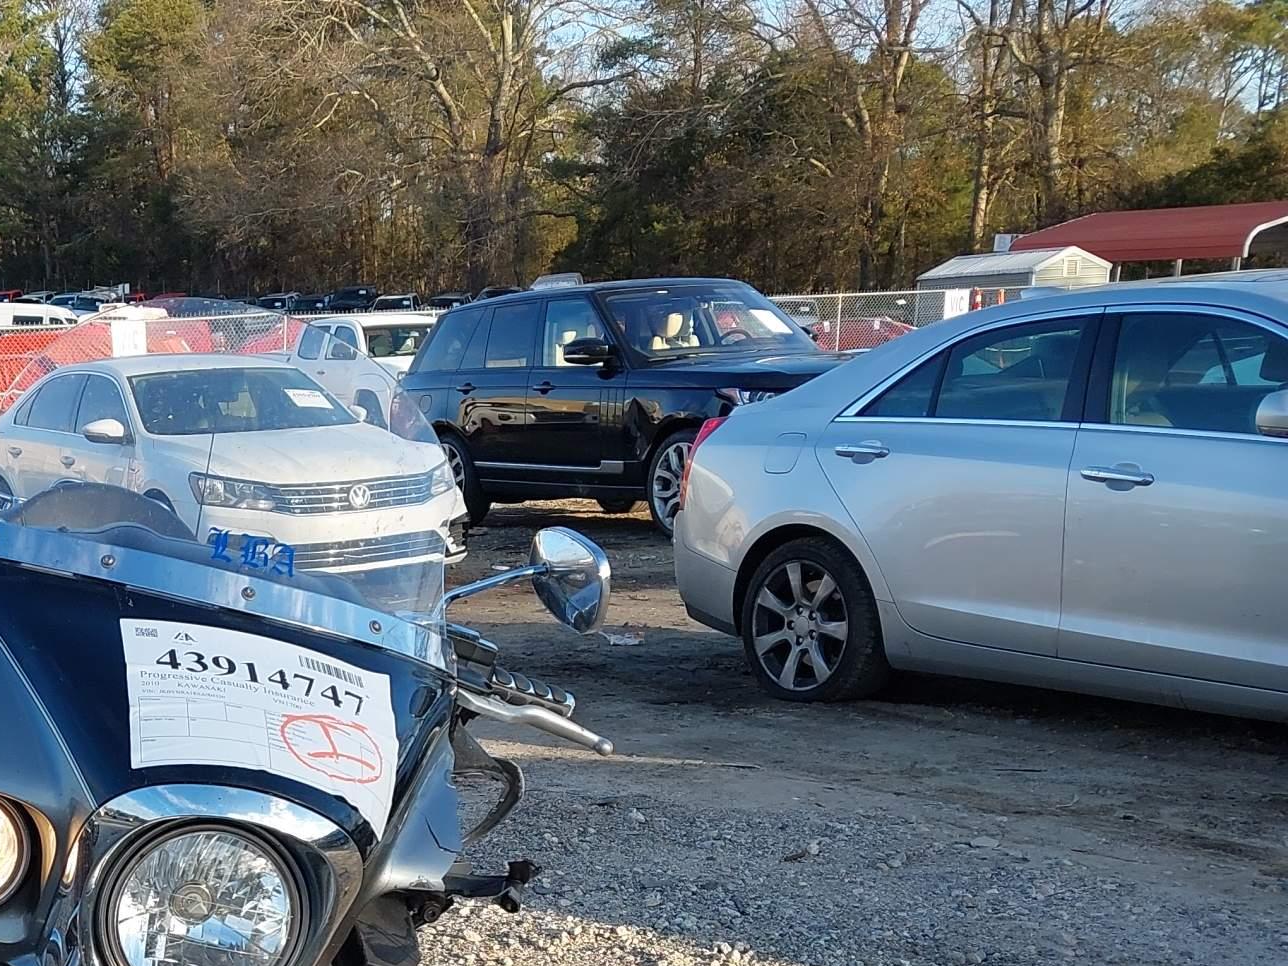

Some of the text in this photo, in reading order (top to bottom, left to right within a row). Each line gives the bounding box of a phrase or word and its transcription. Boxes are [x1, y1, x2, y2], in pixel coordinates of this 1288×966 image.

[139, 670, 315, 707] Progressive Casualty Insurance
[155, 648, 364, 716] 43914747
[177, 682, 226, 693] KAWASAKI
